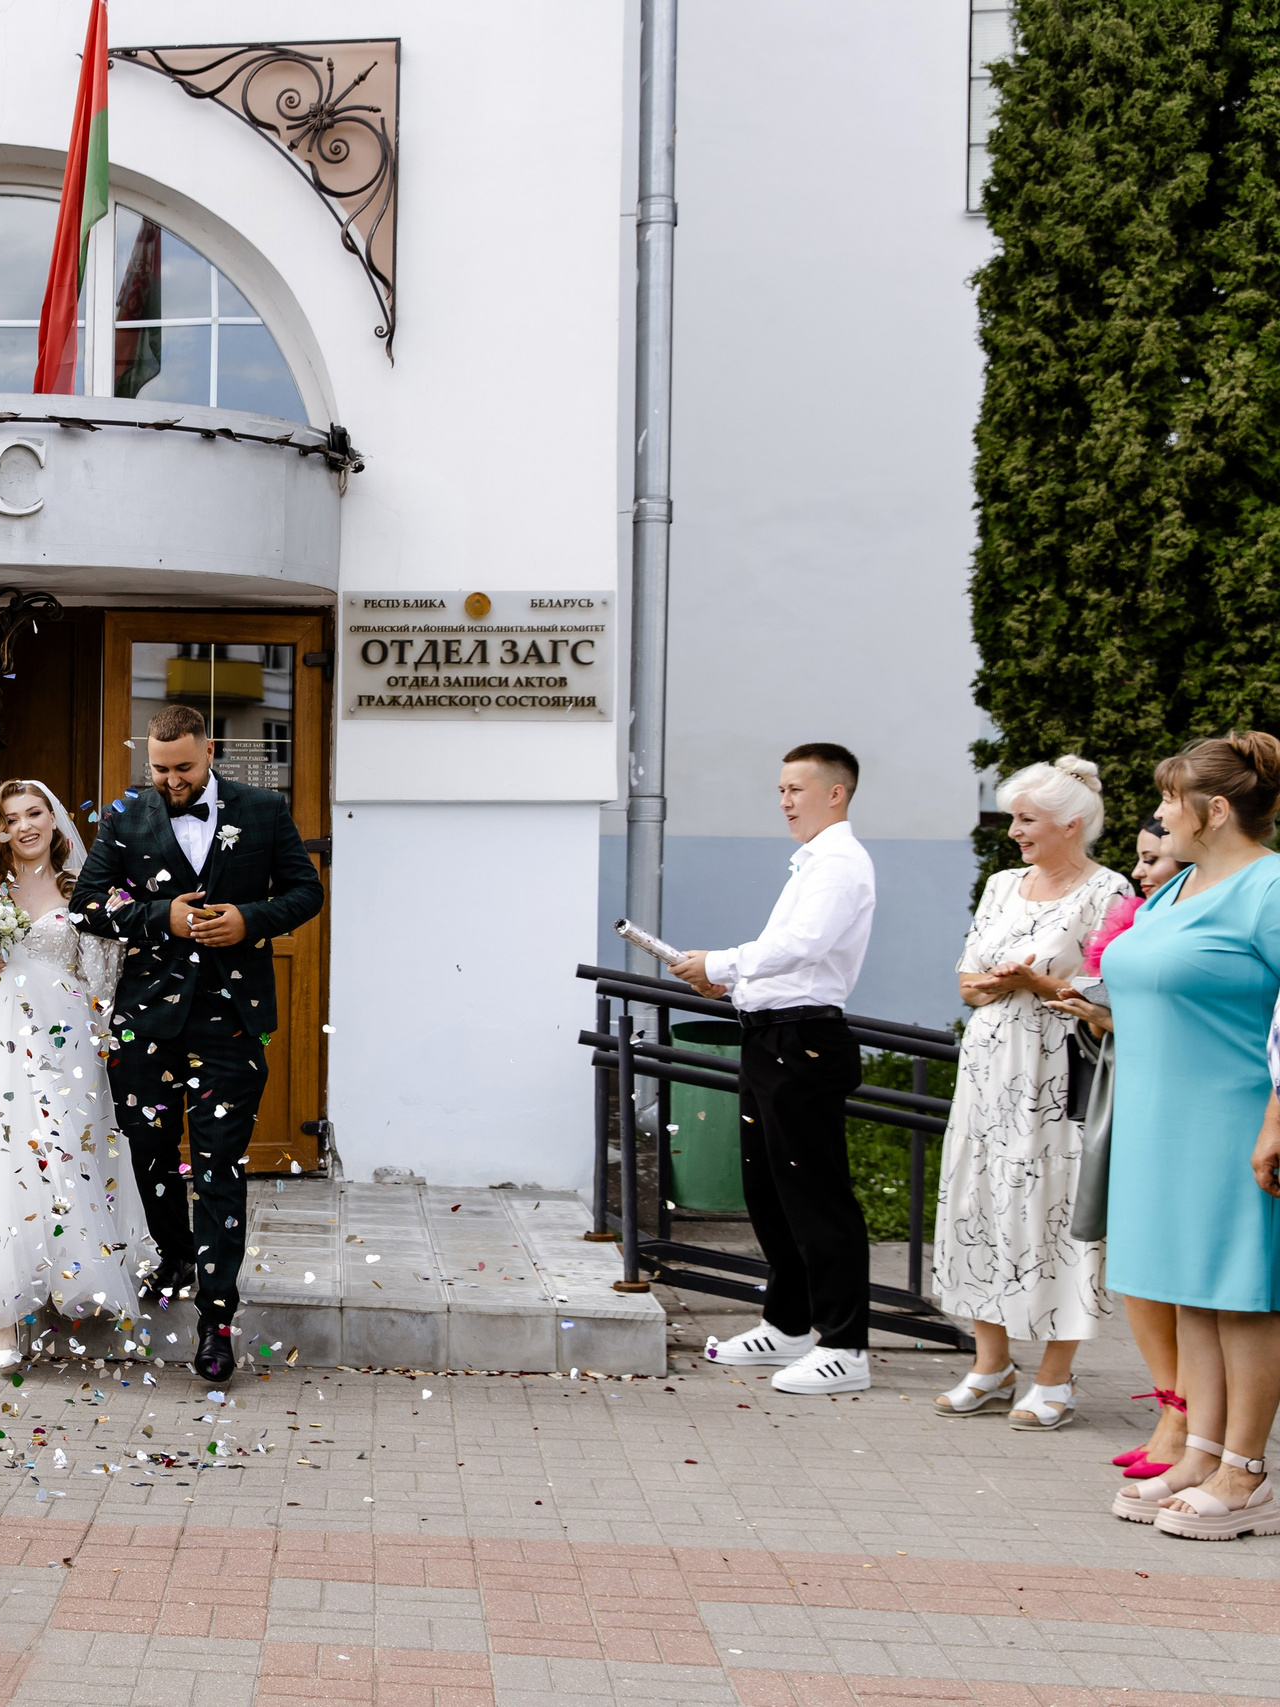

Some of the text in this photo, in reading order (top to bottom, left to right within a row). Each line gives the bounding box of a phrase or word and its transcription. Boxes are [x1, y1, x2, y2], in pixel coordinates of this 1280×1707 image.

[363, 598, 594, 608] РЕСПУБЛИКА БЕЛАРУСЬ
[349, 624, 606, 633] ОРШАНСКИЙ РАЙОННЫЙ ИСПОЛНИТЕЛЬНЫЙ КОМИТЕТ
[361, 639, 595, 672] ОТДЕЛ ЗАГС
[387, 675, 568, 689] ОТДЕЛ ЗАПИСИ АКТОВ
[357, 695, 597, 708] ГРАЖДАНСКОГО СОСТОЯНИЯ
